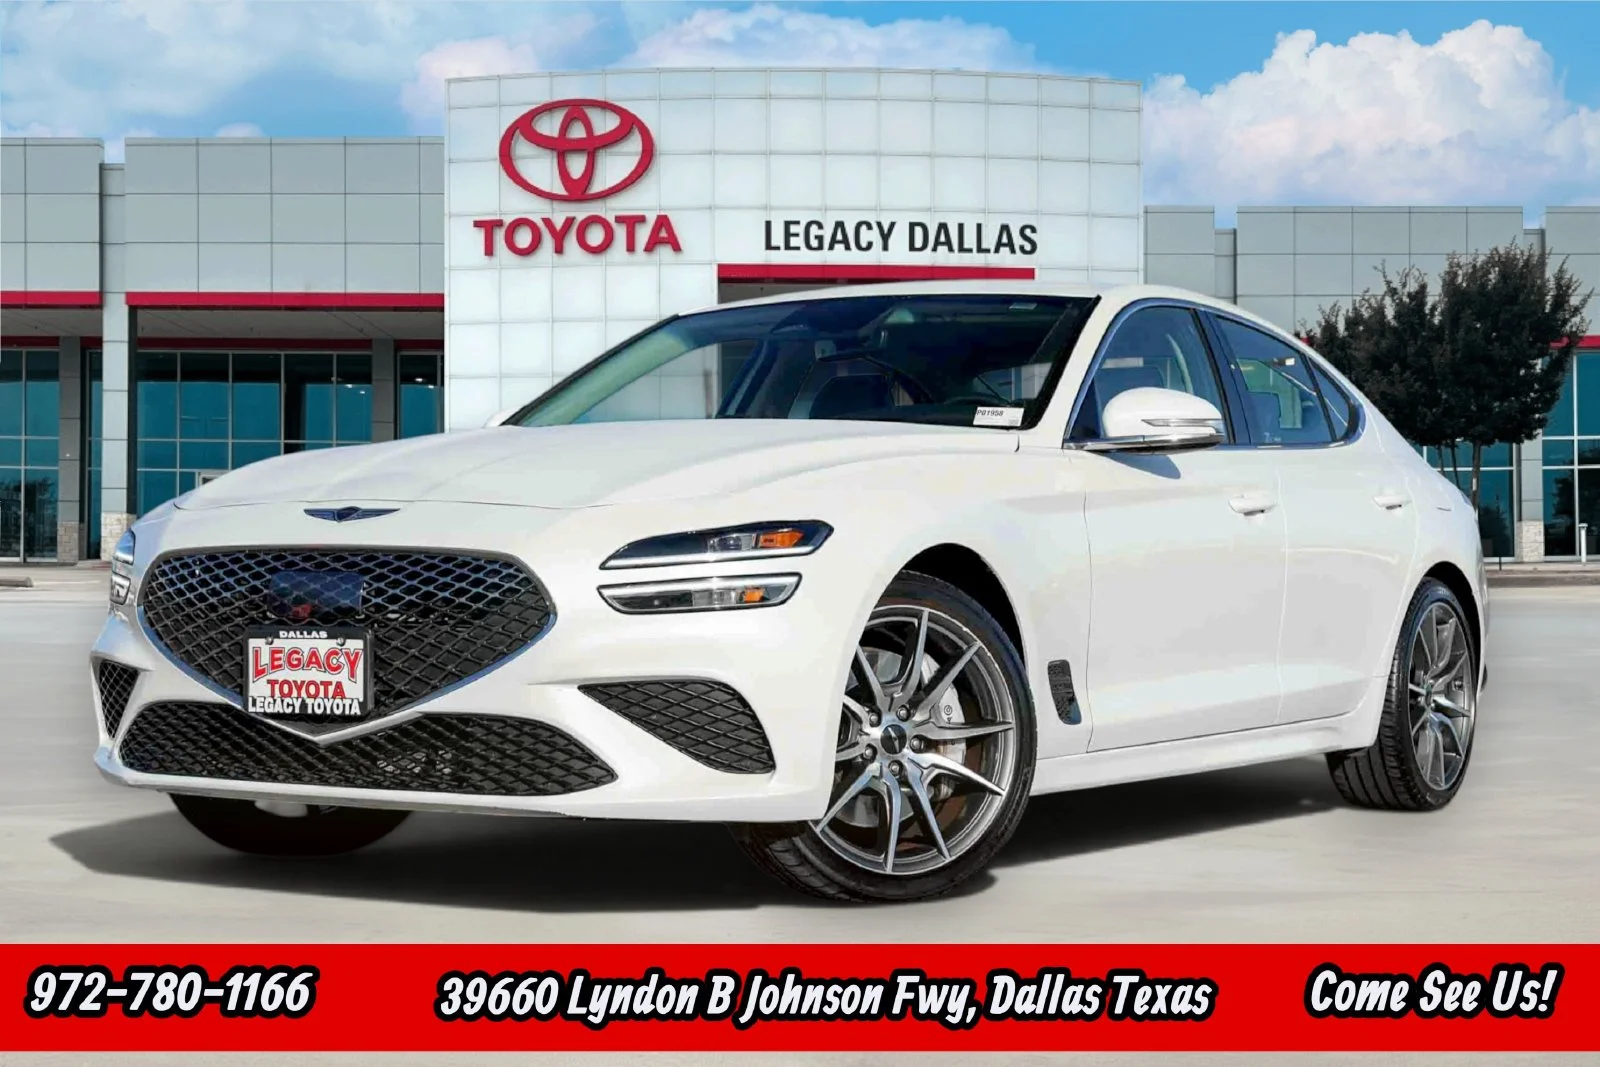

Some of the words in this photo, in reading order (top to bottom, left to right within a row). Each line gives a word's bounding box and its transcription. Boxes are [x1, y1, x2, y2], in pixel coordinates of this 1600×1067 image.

[473, 213, 682, 256] TOYOTA
[764, 218, 896, 252] LEGACY
[907, 220, 1039, 255] DALLAS
[279, 630, 328, 639] DALLAS
[253, 647, 363, 683] LEGACY
[266, 679, 346, 699] TOYOTA
[248, 697, 302, 713] LEGACY
[306, 698, 361, 715] TOYOTA
